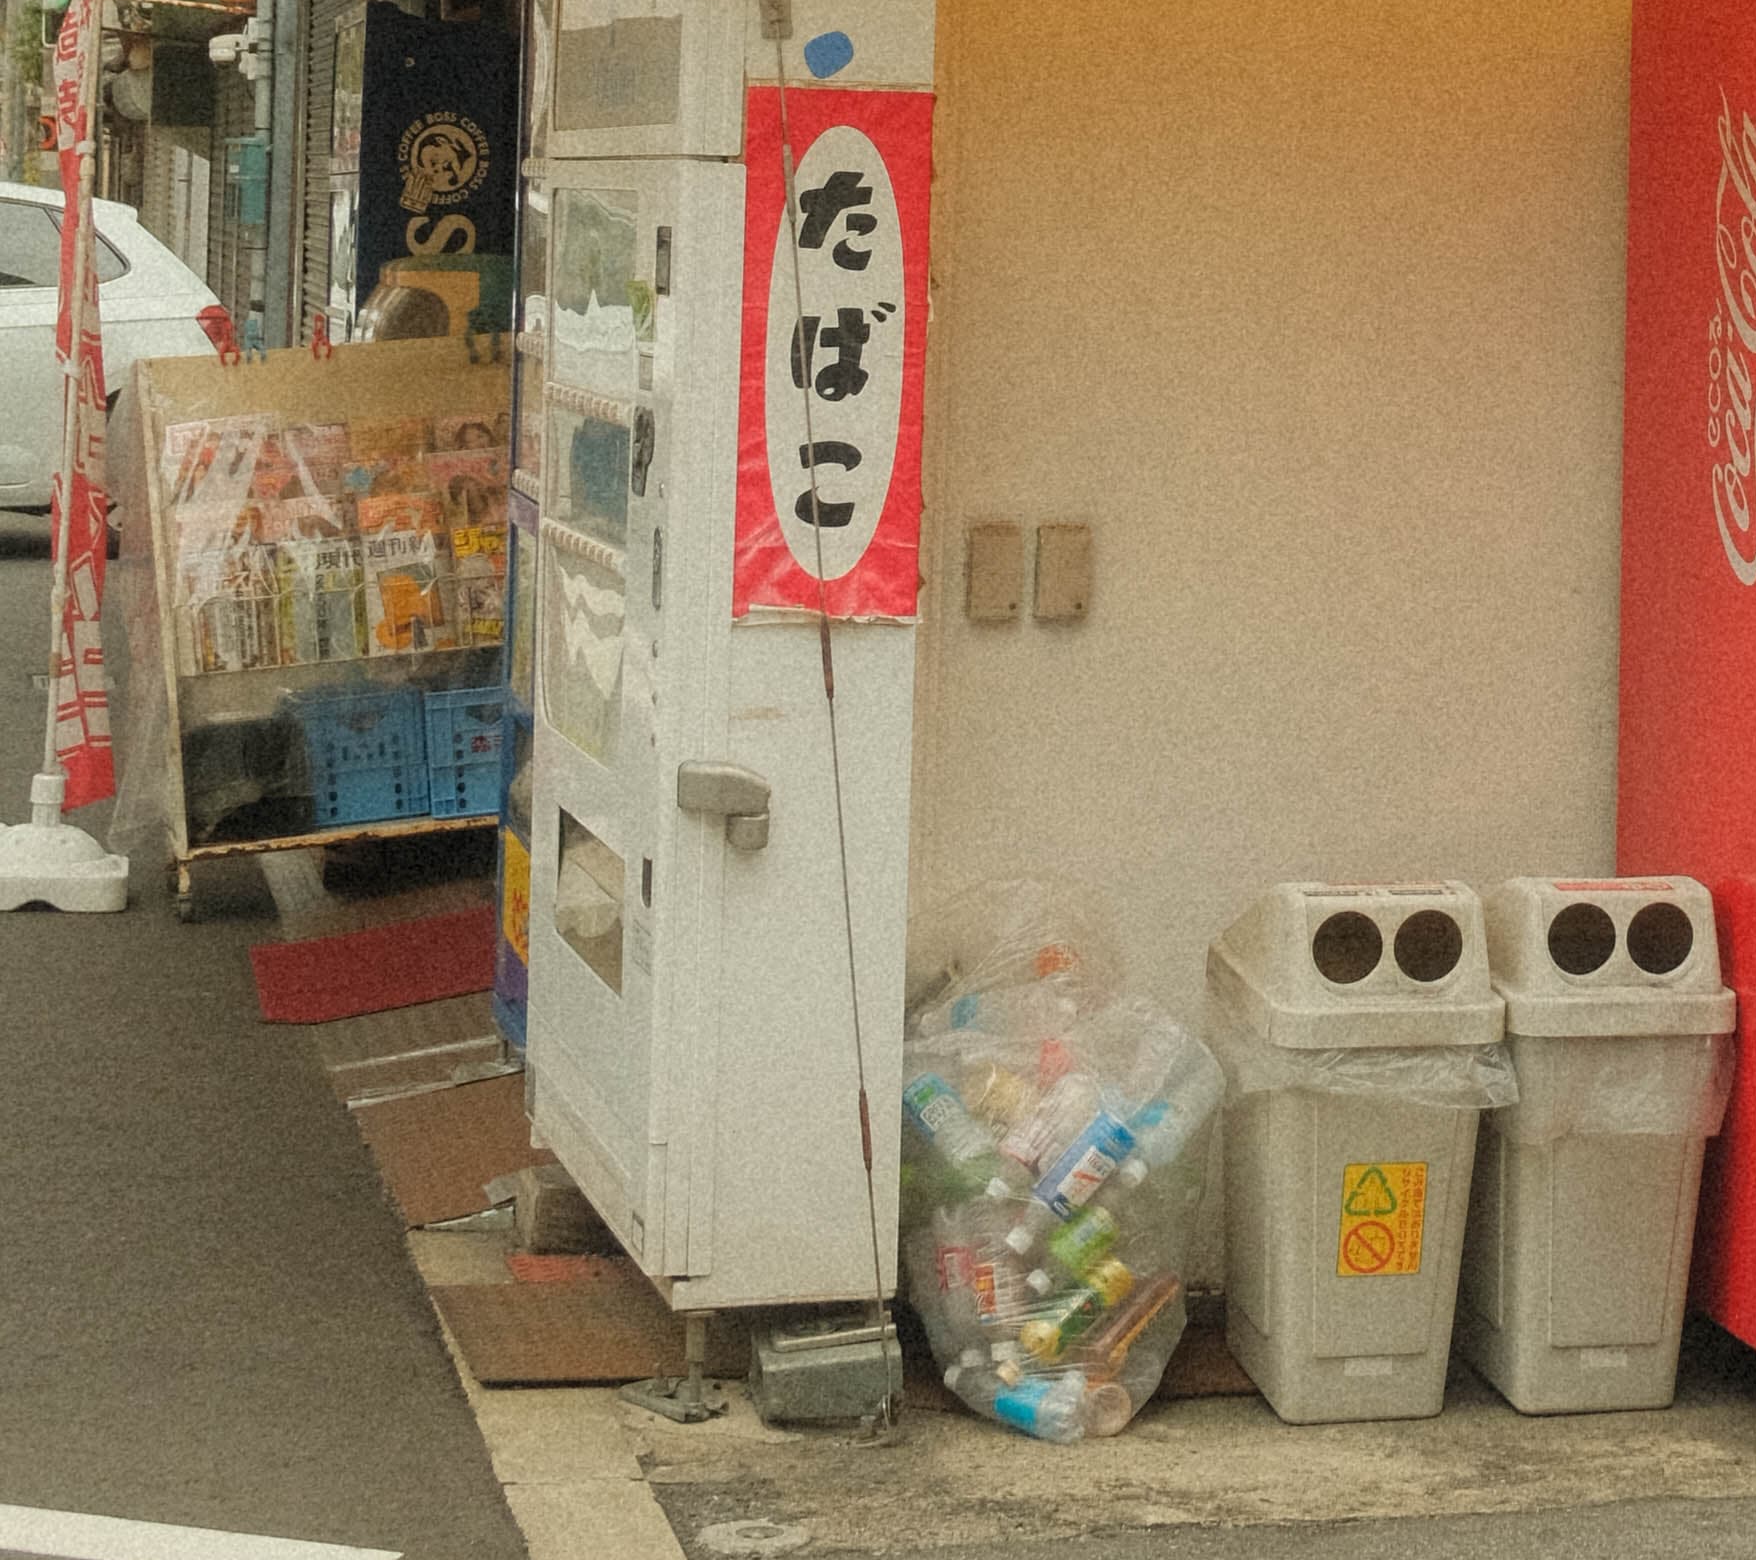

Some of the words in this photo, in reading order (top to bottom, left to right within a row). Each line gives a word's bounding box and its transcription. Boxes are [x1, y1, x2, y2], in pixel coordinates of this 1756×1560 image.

[425, 111, 457, 125] BOSS
[460, 117, 490, 156] COFFEE
[431, 188, 469, 206] COFFE
[791, 170, 897, 529] たばこ
